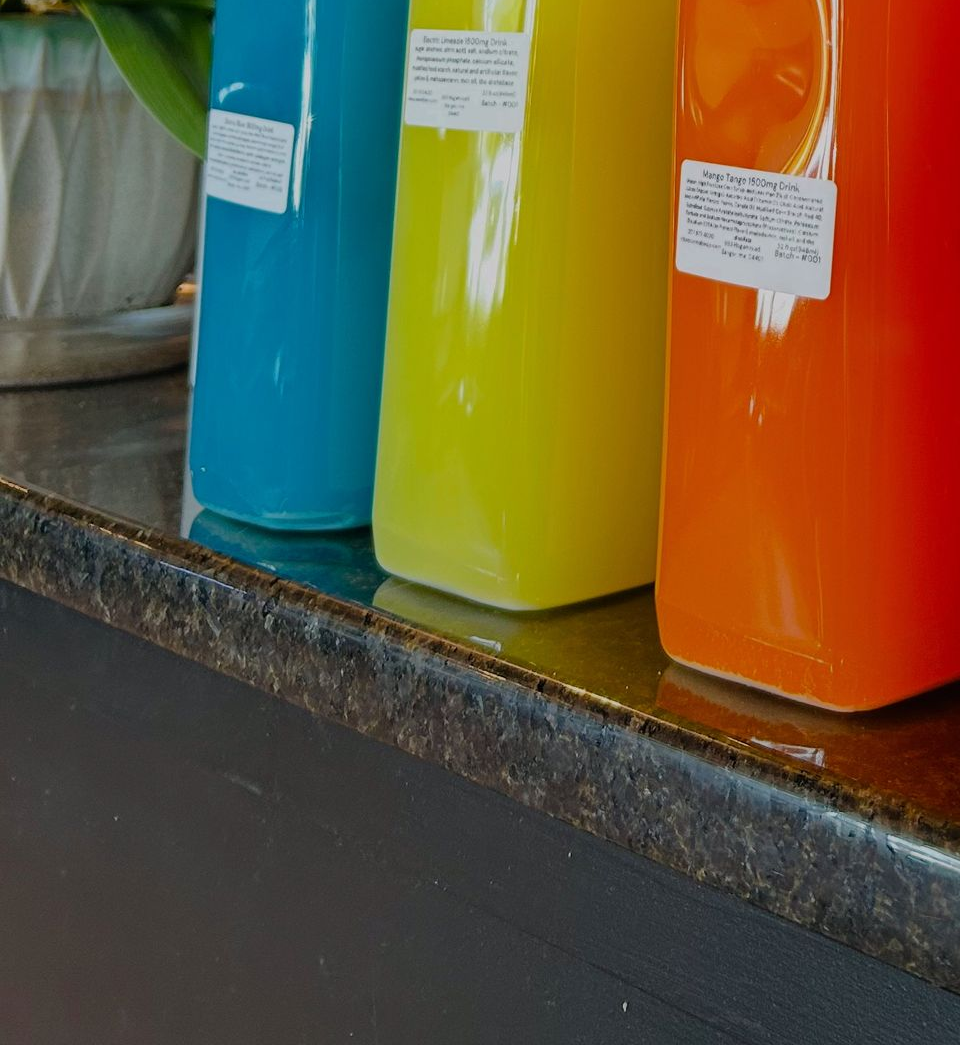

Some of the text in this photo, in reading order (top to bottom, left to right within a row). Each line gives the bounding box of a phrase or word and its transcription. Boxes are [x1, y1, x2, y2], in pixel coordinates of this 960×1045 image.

[703, 169, 724, 183] Mango
[726, 173, 746, 186] Tango
[749, 176, 778, 192] 1500mg
[780, 182, 800, 193] Drink
[774, 250, 795, 259] Batch
[802, 254, 821, 264] #001
